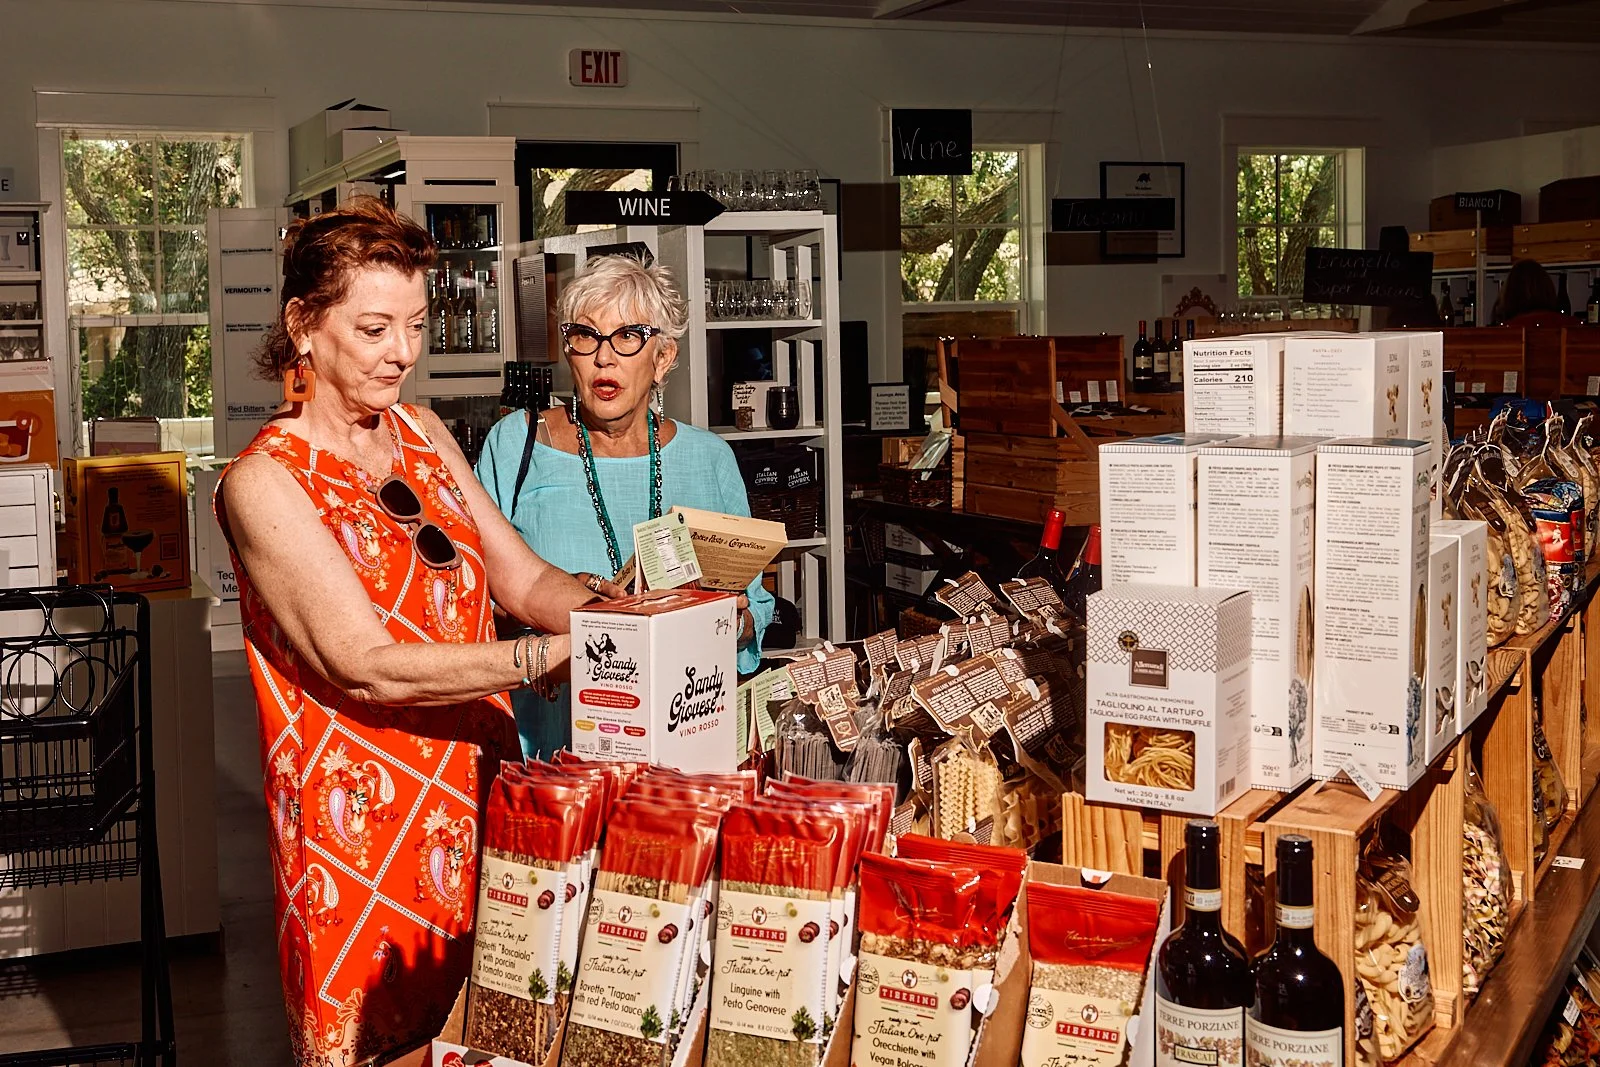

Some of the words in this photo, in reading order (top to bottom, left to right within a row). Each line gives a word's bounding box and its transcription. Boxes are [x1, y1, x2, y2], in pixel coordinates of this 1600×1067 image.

[581, 50, 621, 84] EXIT
[898, 127, 963, 161] Wine
[618, 197, 671, 217] WINE
[1458, 196, 1494, 208] BIANCO
[1064, 201, 1146, 229] Tuscany
[1234, 374, 1253, 382] 210
[228, 405, 242, 413] Red
[243, 405, 266, 413] Bitters
[787, 476, 811, 487] COWBOY
[788, 471, 808, 481] ITALIAN
[604, 651, 637, 674] Sandy
[592, 663, 631, 682] Giovese
[932, 684, 948, 694] ITALIAN
[947, 673, 969, 685] MACARONI
[969, 665, 987, 677] PRODUCT
[685, 665, 723, 700] Sandy
[1119, 693, 1158, 701] GASTRONOMIA
[1160, 697, 1194, 705] PIEMONTESE
[667, 692, 717, 732] Giovese
[1096, 699, 1145, 711] TAGLIOLINO
[1147, 705, 1158, 713] AL
[1161, 706, 1204, 717] TARTUFO
[680, 726, 697, 737] VINO
[699, 718, 719, 732] ROSSO
[1124, 712, 1139, 720] EGG
[1139, 714, 1161, 722] PASTA
[1162, 716, 1180, 724] WITH
[1181, 719, 1212, 727] TRUFFLE
[1126, 797, 1145, 805] MADE
[488, 889, 527, 905] TIBERINO
[478, 921, 502, 937] Italian
[503, 929, 528, 944] One-pot
[600, 923, 646, 940] TIBERINO
[733, 926, 785, 940] TIBERINO
[475, 939, 496, 952] paghetti
[483, 953, 494, 962] with
[495, 956, 516, 968] porcini
[584, 957, 615, 973] Italian
[617, 965, 647, 980] One-pot
[483, 964, 503, 977] tomato
[505, 971, 522, 983] sauce
[721, 959, 758, 976] Italian
[759, 965, 792, 981] One-pot
[860, 972, 874, 980] 100%
[580, 980, 604, 995] Bavette
[730, 982, 762, 997] Linguine
[765, 988, 780, 999] with
[574, 993, 585, 1002] with
[587, 996, 599, 1006] red
[602, 1000, 619, 1011] Pesto
[621, 1004, 642, 1016] sauce
[881, 987, 936, 1006] TIBERINO
[723, 996, 743, 1009] Pesto
[745, 1000, 787, 1015] Genovese
[1032, 1007, 1047, 1015] 100%
[1159, 1010, 1185, 1027] TERRE
[1187, 1019, 1240, 1031] PORZIANE
[868, 1019, 906, 1038] Italian
[908, 1028, 943, 1045] One-pot
[1059, 1024, 1117, 1041] TIBERINO
[873, 1037, 919, 1056] Orecchiette
[921, 1049, 936, 1059] with
[1176, 1048, 1216, 1062] FRASCATI
[1273, 1039, 1328, 1054] PORZIANE
[870, 1051, 894, 1066] Vegan
